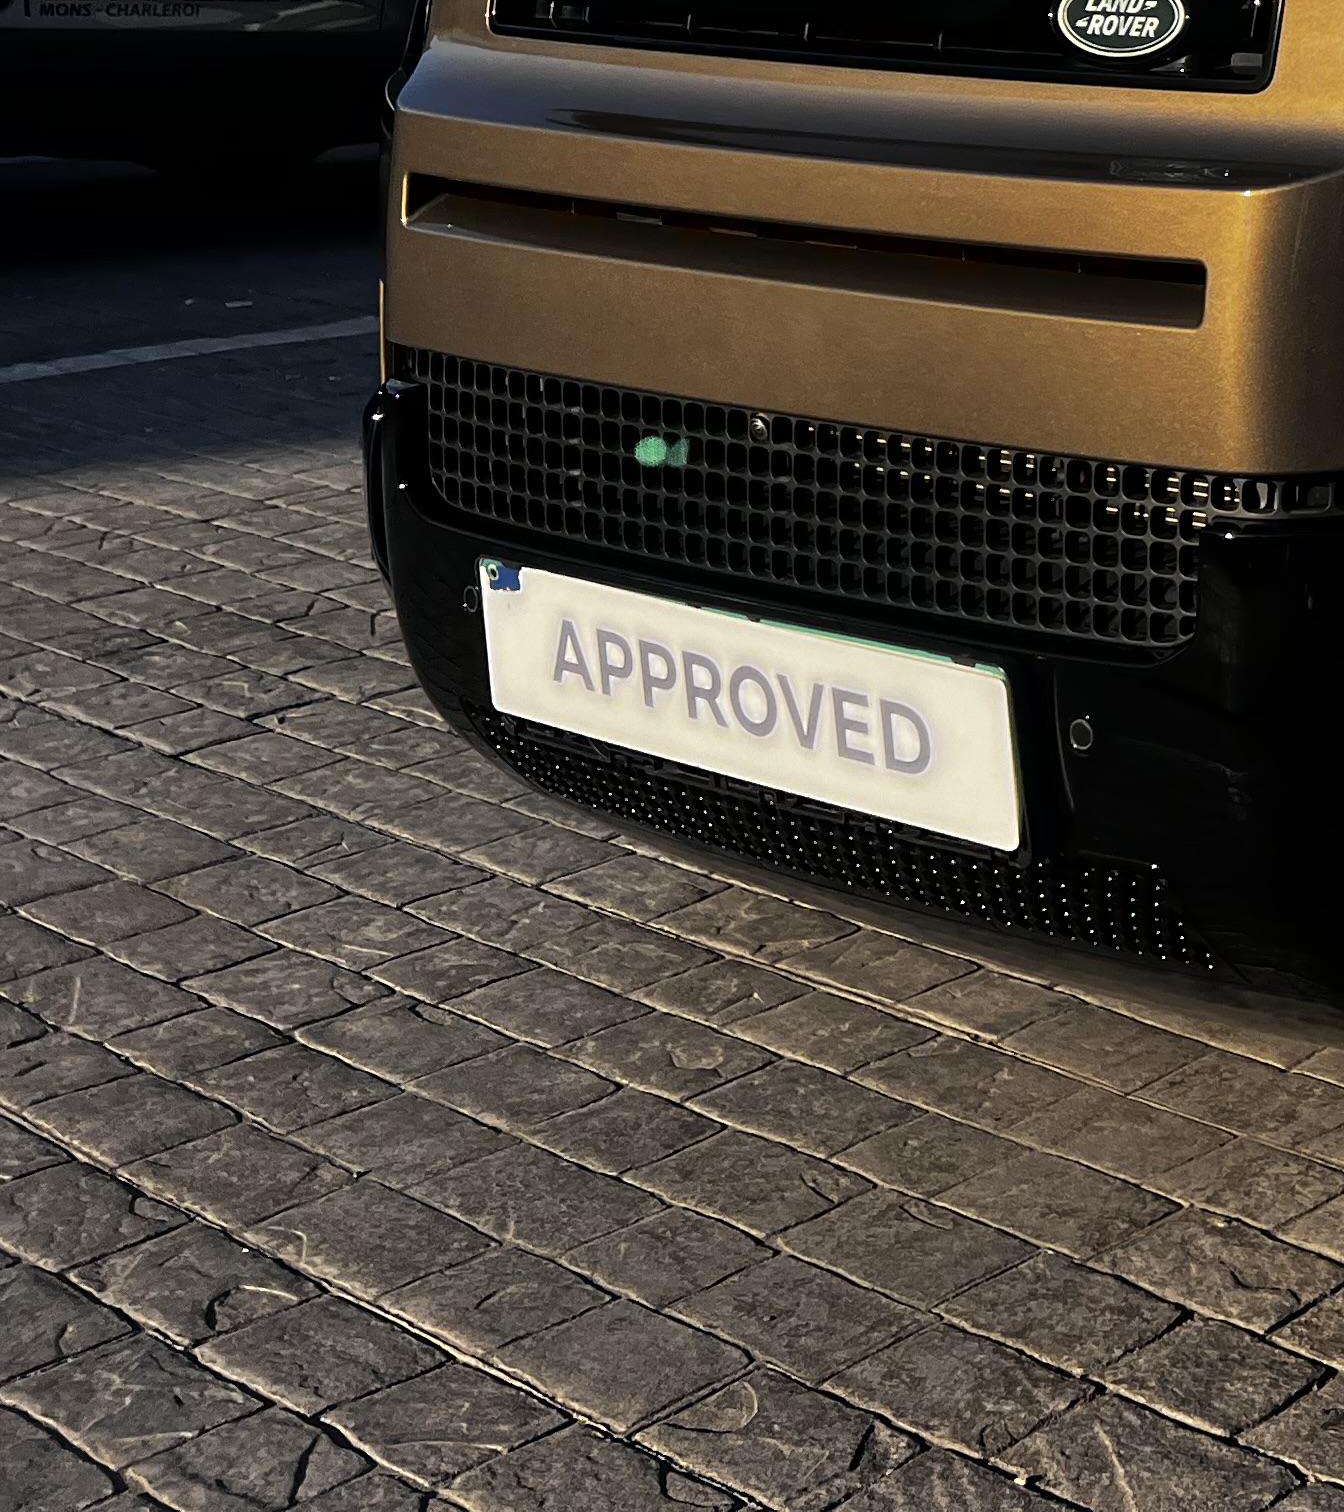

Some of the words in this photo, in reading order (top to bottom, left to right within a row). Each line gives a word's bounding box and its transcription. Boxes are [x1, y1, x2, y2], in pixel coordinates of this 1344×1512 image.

[39, 3, 93, 18] MONS
[105, 3, 201, 18] CHARLEROI
[552, 619, 932, 776] APPROVED
